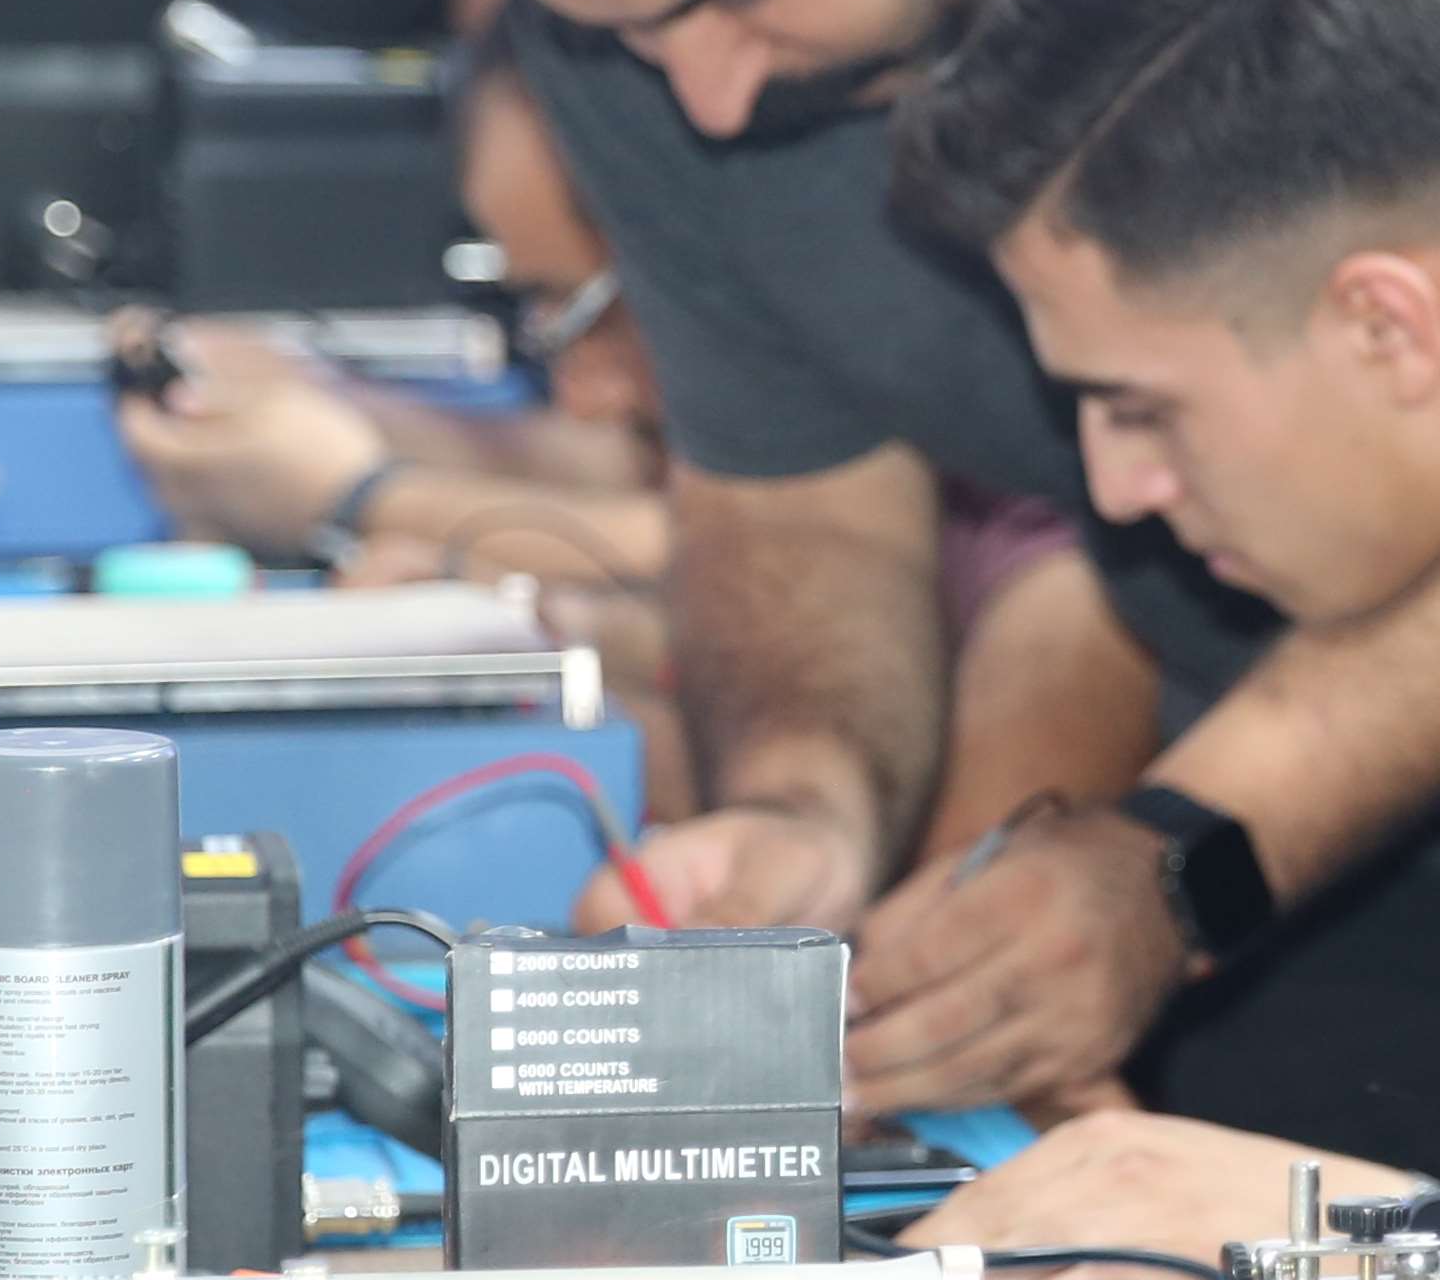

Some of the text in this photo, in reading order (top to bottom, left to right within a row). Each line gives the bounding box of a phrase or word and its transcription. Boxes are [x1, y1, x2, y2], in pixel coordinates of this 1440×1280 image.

[517, 954, 639, 971] 2000 COUNTS
[14, 975, 50, 984] BOARD
[100, 970, 130, 982] SPRAY
[517, 990, 640, 1007] 4000 COUNTS
[517, 1028, 640, 1046] 6000 COUNTS
[518, 1062, 630, 1078] 6000 COUNTS
[518, 1078, 658, 1096] WITH TEMPERATURE
[37, 1165, 111, 1177] электронных
[479, 1144, 822, 1187] DIGITAL MULTIMETER
